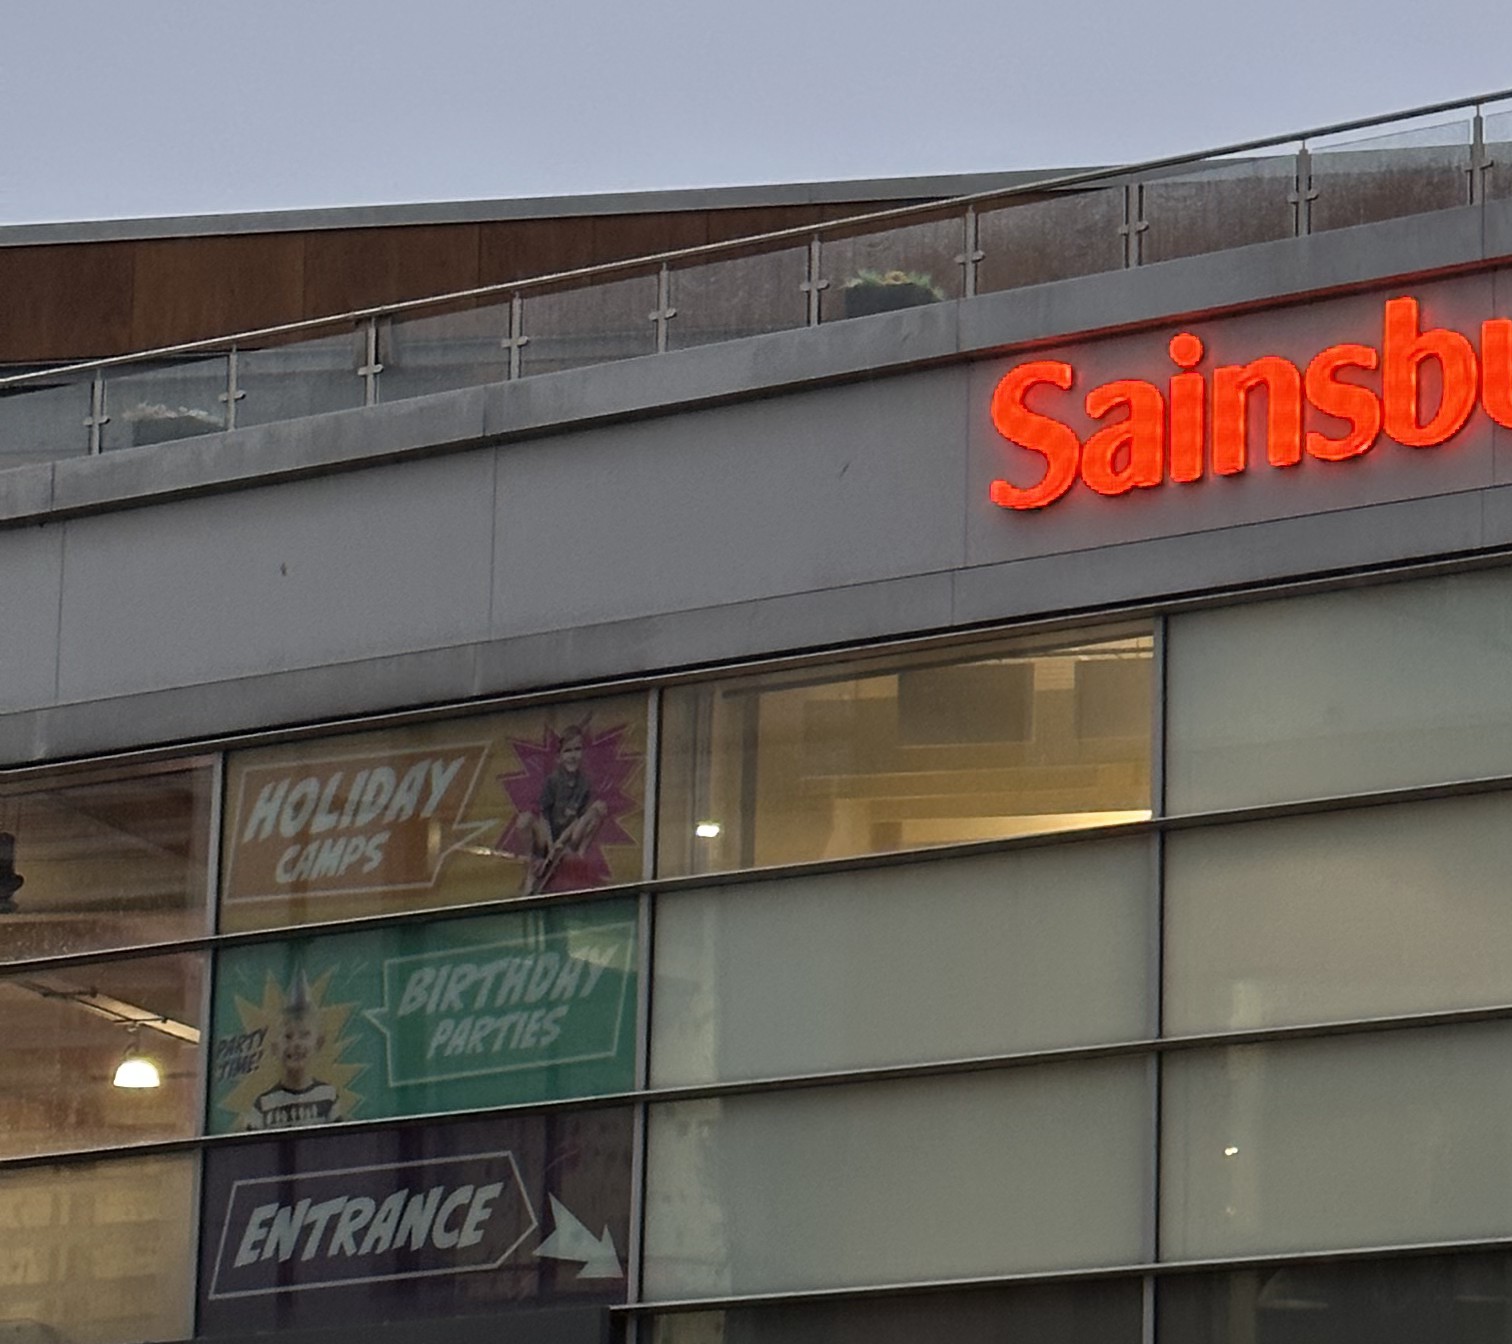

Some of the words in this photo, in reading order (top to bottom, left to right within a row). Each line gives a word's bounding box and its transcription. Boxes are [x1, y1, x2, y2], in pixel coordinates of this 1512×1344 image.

[241, 756, 465, 844] HOLIDAY
[275, 829, 392, 884] CAMPS
[397, 944, 619, 1019] BIRTHDAY
[217, 1025, 269, 1058] PARTY
[426, 1004, 570, 1060] PARTIES
[233, 1181, 504, 1268] ENTRANCE
